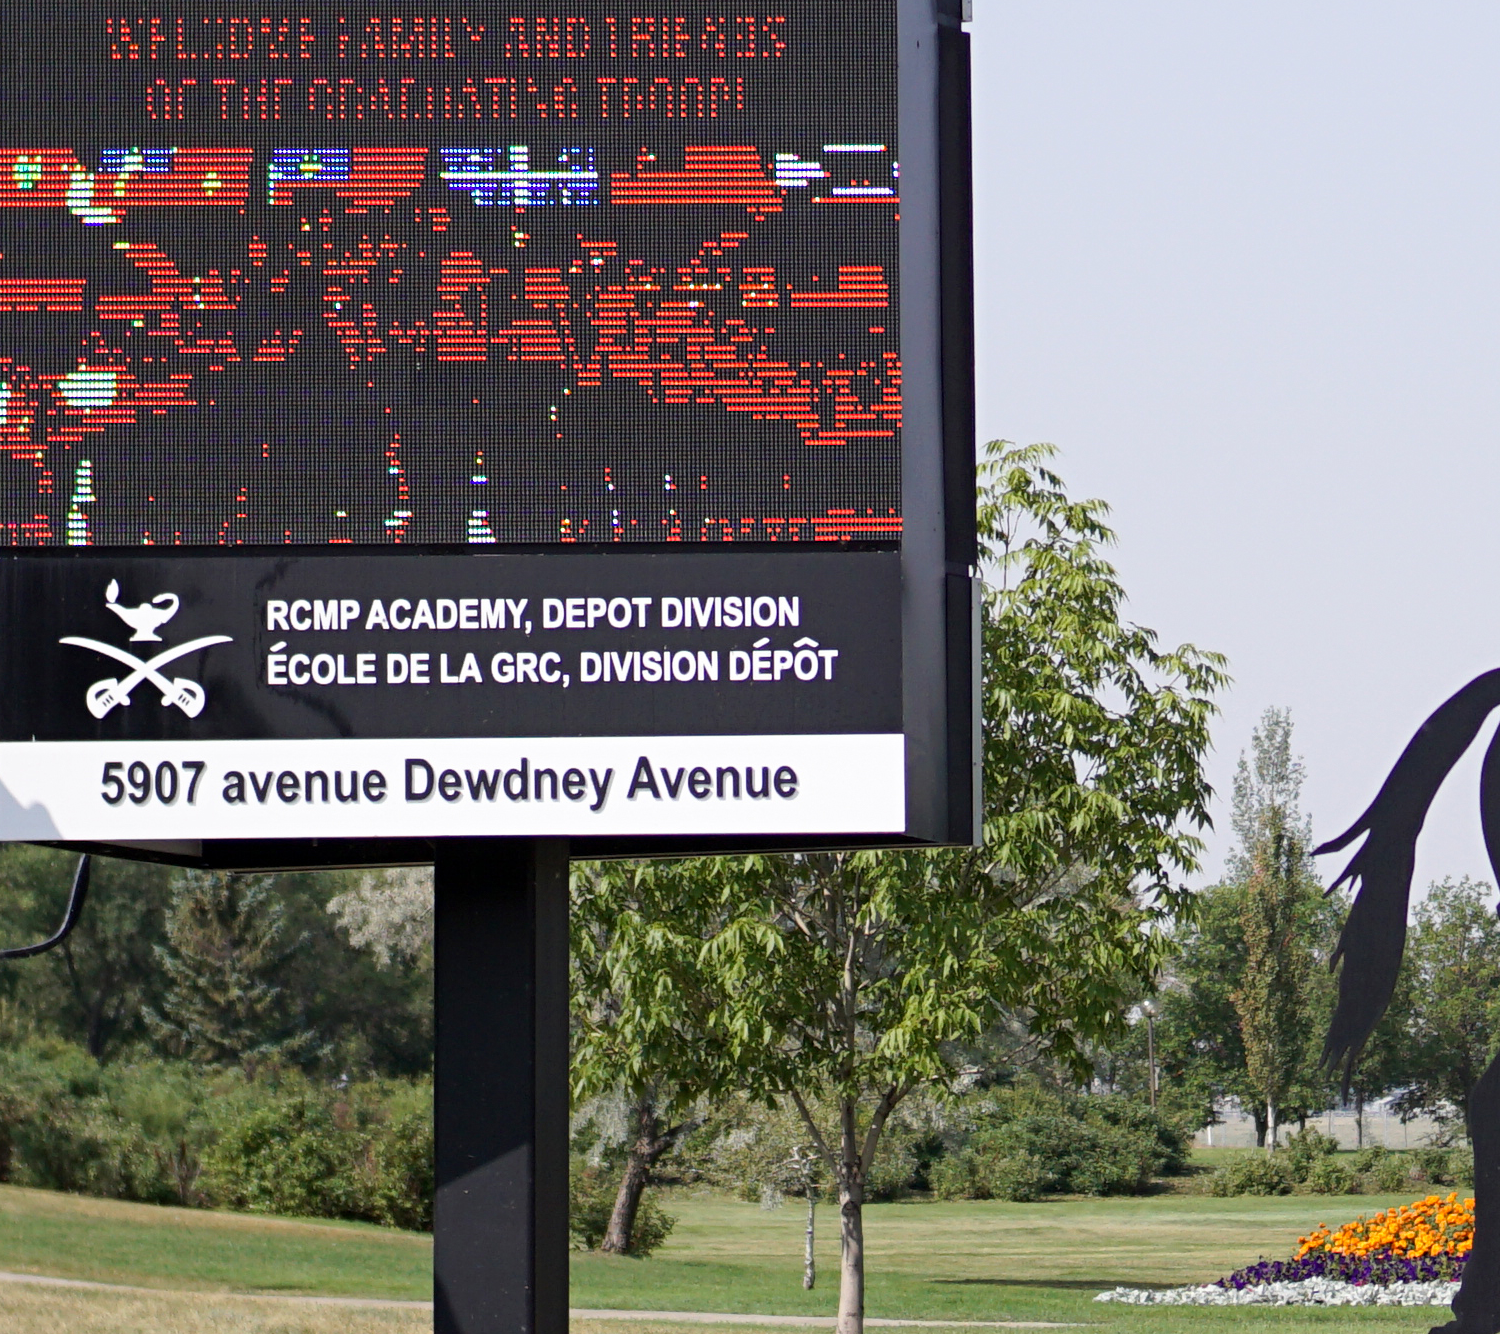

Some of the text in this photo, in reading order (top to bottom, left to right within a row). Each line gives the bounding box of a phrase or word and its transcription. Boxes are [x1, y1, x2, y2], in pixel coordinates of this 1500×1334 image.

[266, 596, 800, 635] RCMP ACADEMY, DEPOT DIVISION
[266, 637, 839, 687] ÉCOLE DE LA GRC, DIVISION DÉPÔT
[100, 756, 800, 812] 5907 avenue Dewdney Avenue
